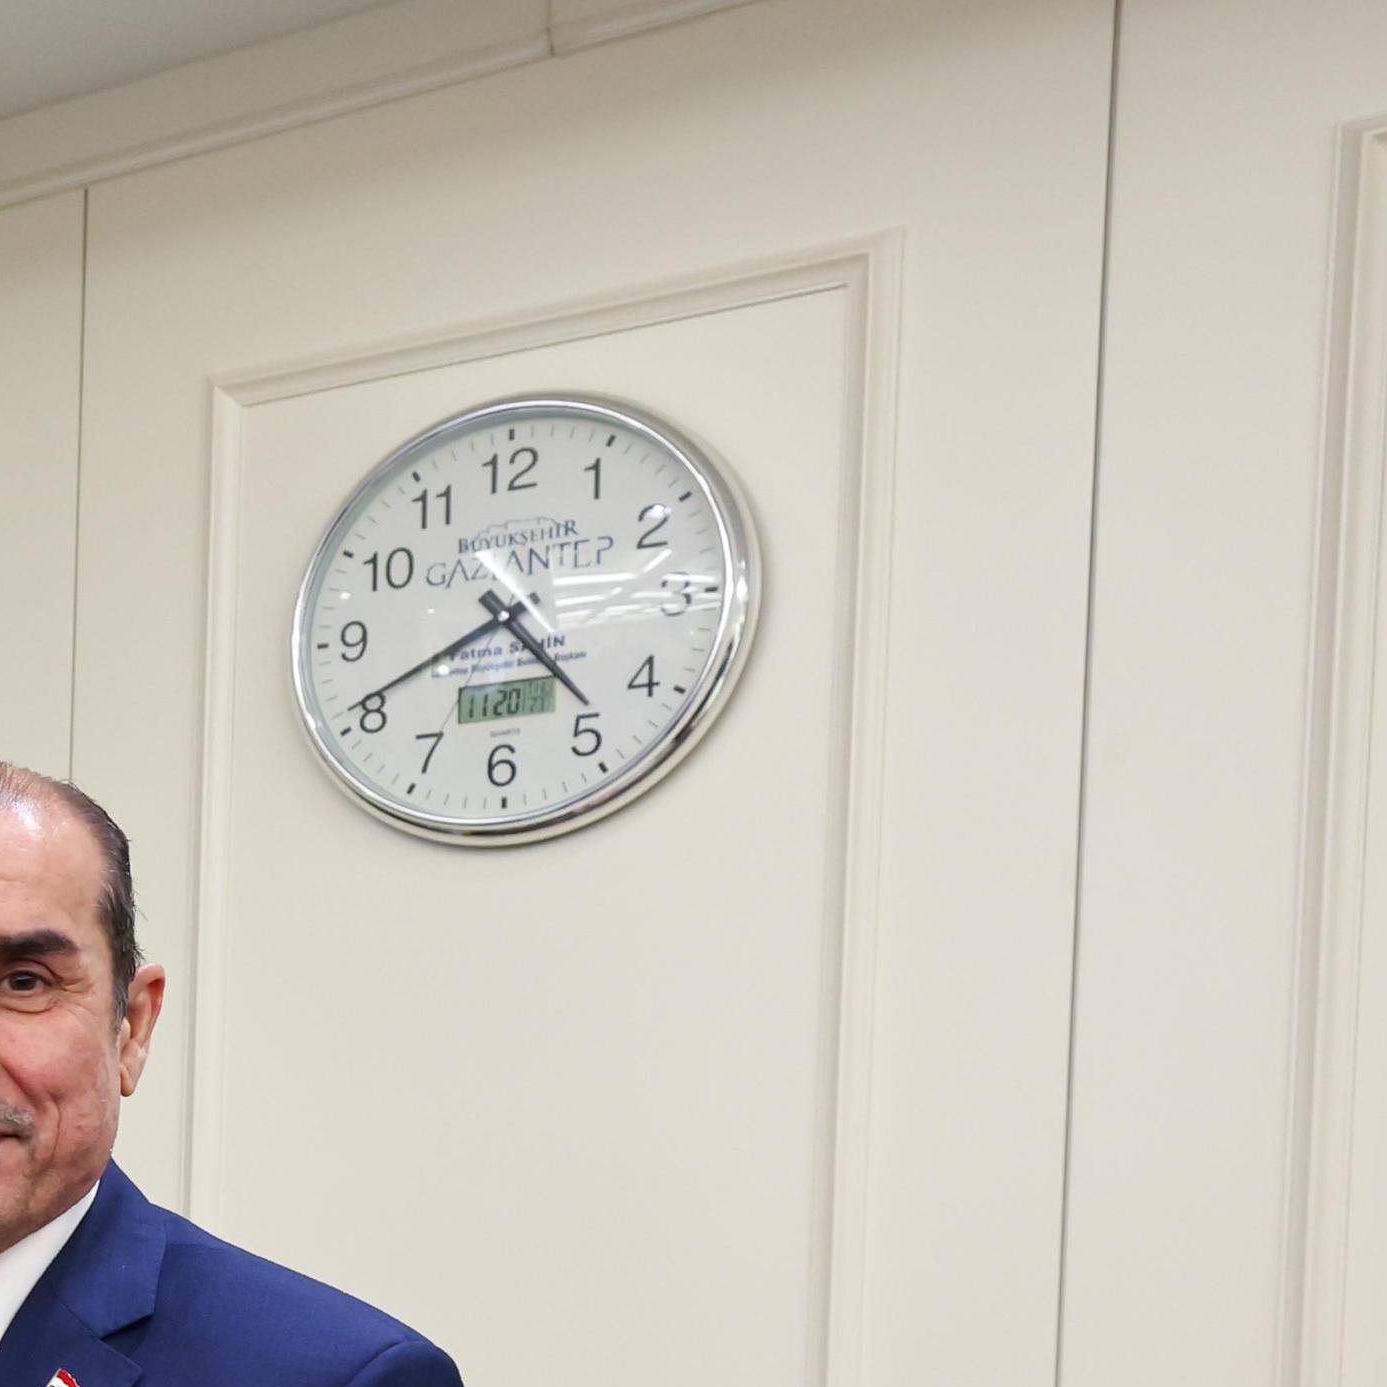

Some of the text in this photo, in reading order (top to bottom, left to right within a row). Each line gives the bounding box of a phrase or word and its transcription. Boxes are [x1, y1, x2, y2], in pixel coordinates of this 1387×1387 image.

[482, 447, 539, 495] 12
[584, 457, 602, 500] 1
[412, 485, 453, 529] 11
[636, 504, 670, 550] 2
[363, 547, 414, 592] 10
[426, 536, 614, 588] GAZANTEP
[660, 571, 693, 617] 3
[339, 621, 369, 662] 9
[627, 654, 661, 698] 4
[358, 692, 388, 733] 8
[571, 712, 603, 757] 5
[415, 731, 445, 774] 7
[487, 744, 517, 787] 6
